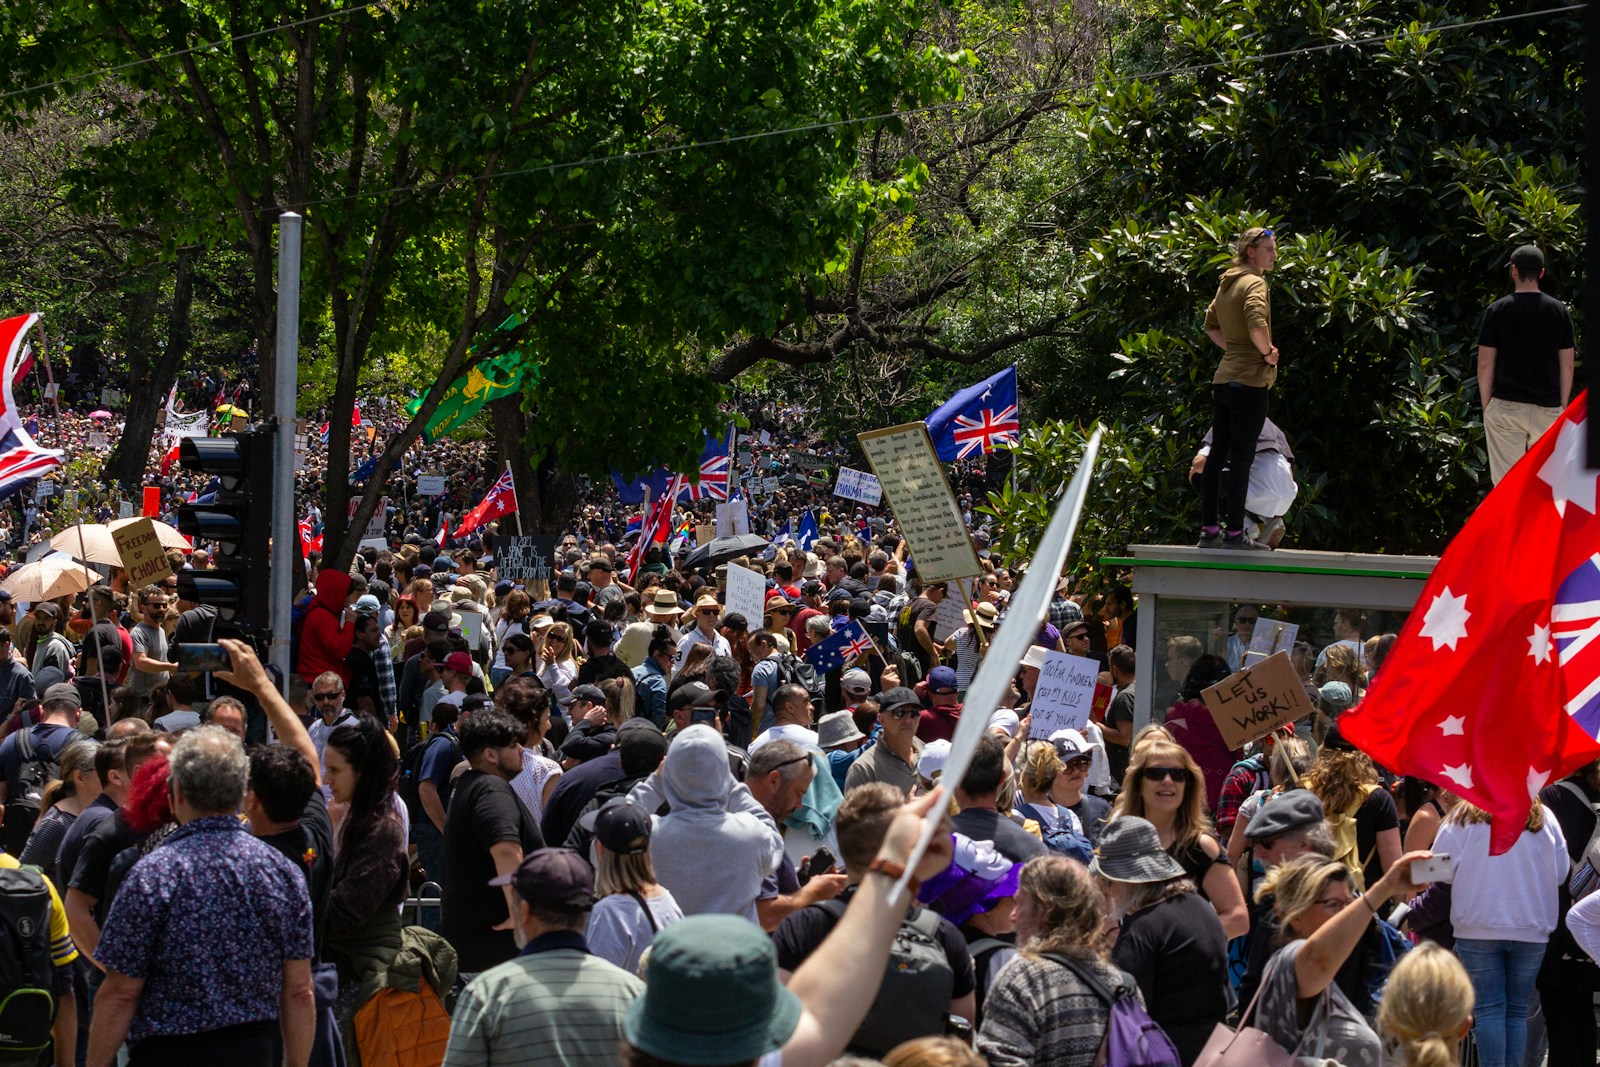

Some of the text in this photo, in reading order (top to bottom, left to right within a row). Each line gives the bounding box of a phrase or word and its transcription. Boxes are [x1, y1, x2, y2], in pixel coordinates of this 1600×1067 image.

[841, 468, 853, 477] MY
[942, 510, 953, 518] they
[115, 531, 158, 554] FREEDOM
[510, 536, 532, 548] IN 2021
[134, 550, 143, 560] OF
[496, 545, 538, 558] A SPINE IS
[130, 555, 169, 582] CHOICE
[536, 556, 548, 568] THE
[1052, 660, 1066, 681] FAR
[1038, 686, 1051, 700] KEEP
[1052, 686, 1062, 698] MY
[1062, 690, 1083, 705] KIDS
[1216, 671, 1253, 704] LET
[1244, 688, 1267, 704] US
[1232, 688, 1300, 730] WORK!!
[1032, 708, 1076, 729] OUT OF YOUR
